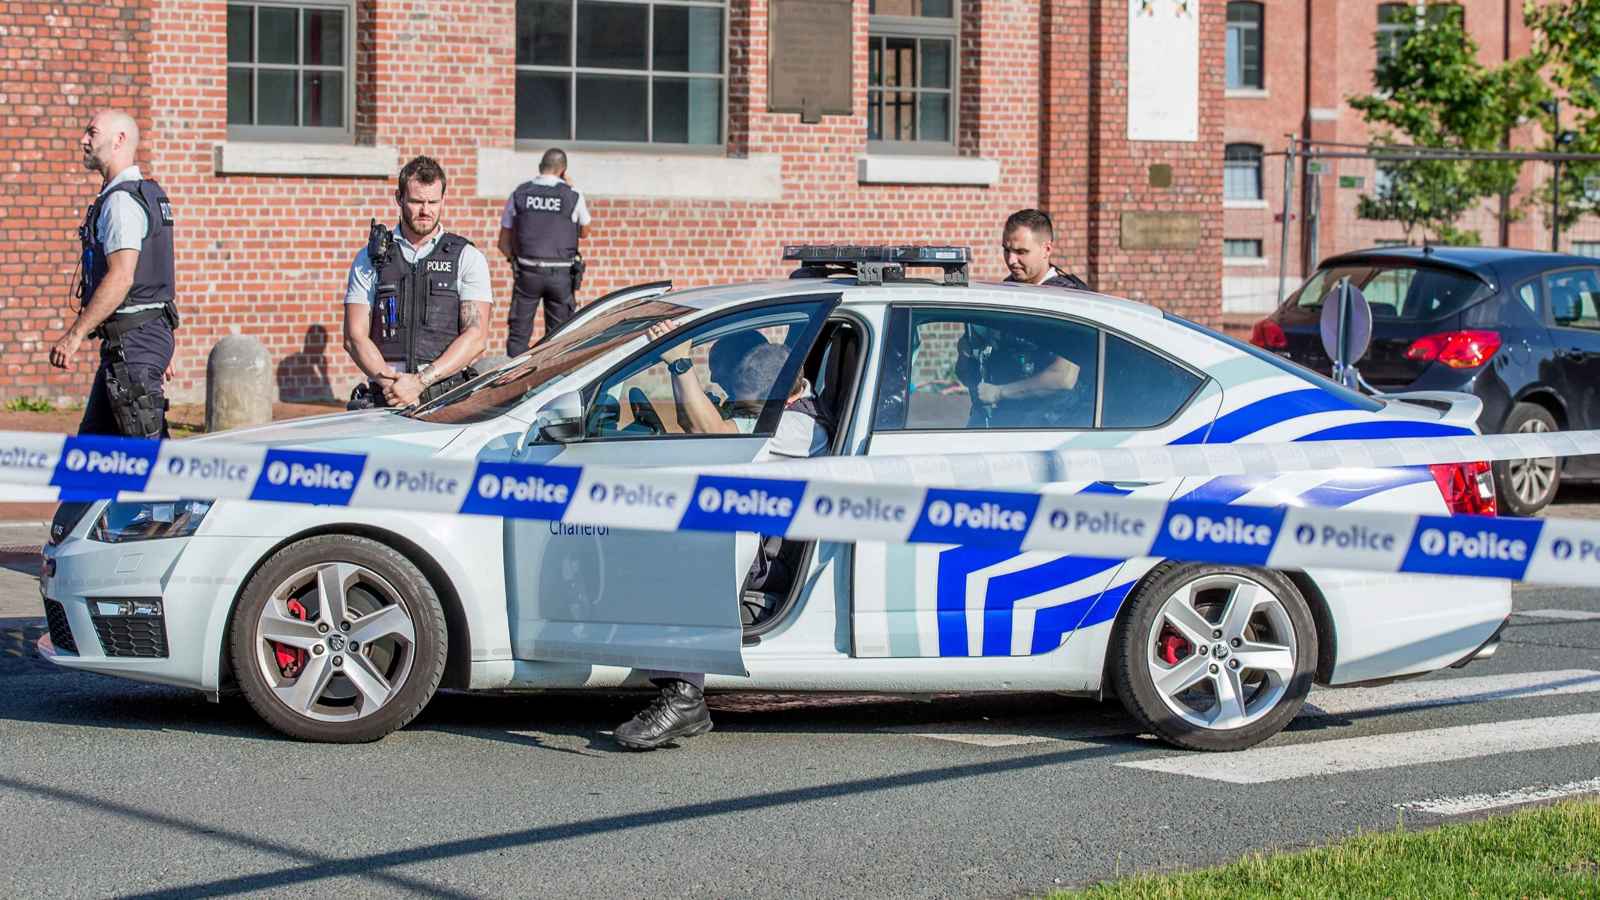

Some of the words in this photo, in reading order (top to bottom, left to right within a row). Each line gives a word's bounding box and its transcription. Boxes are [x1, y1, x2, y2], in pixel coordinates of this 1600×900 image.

[527, 196, 560, 211] POLICE
[427, 261, 451, 272] POLICE
[0, 446, 48, 468] olice
[87, 450, 149, 476] Police
[190, 456, 248, 481] Police
[290, 463, 354, 490] Police
[396, 470, 459, 495] Police
[502, 476, 570, 504] Police
[613, 484, 677, 508] Police
[723, 486, 792, 516] Police
[839, 497, 906, 523] Police
[954, 502, 1027, 531] Police
[1075, 510, 1145, 537] Police
[1196, 516, 1272, 545] Police
[1321, 524, 1395, 551] Police
[1447, 531, 1526, 561] Police
